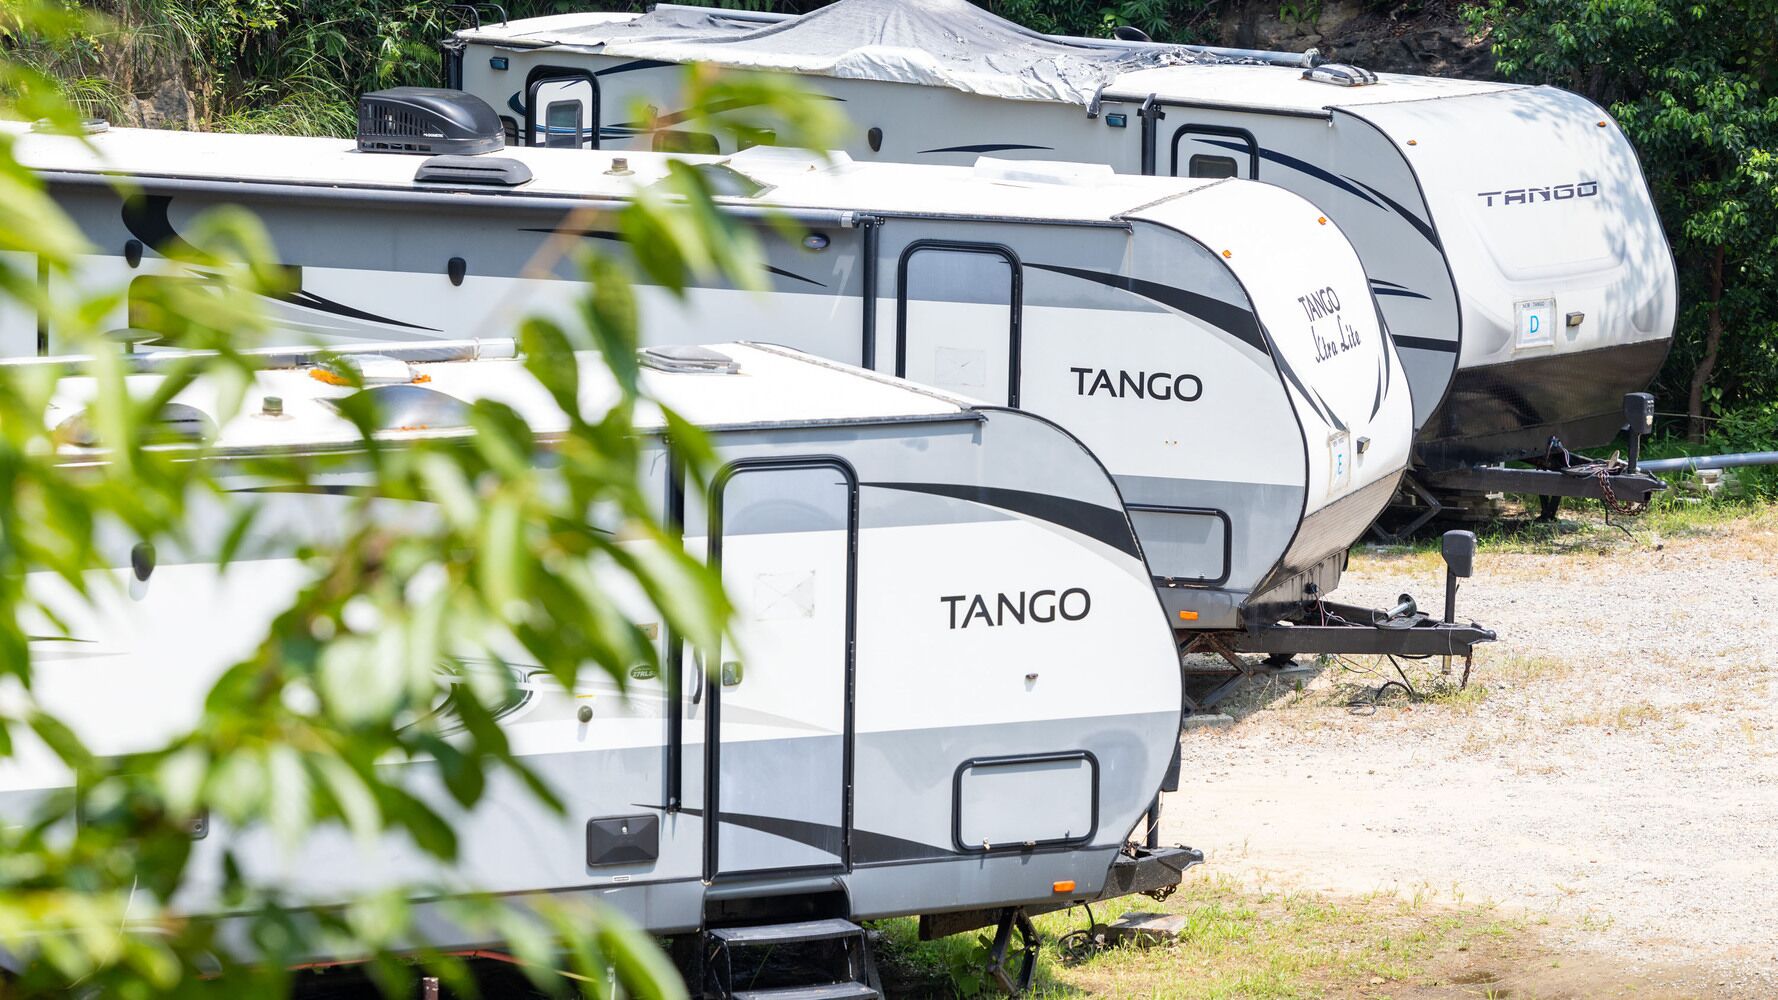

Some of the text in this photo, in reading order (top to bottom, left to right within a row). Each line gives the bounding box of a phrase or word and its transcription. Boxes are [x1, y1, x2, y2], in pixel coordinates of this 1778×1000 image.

[1477, 180, 1598, 208] TANGO
[1297, 286, 1341, 322] TANGO
[1311, 314, 1361, 363] Xtra Lite
[1530, 315, 1539, 333] D
[1070, 366, 1203, 402] TANGO
[940, 587, 1091, 630] TANGO
